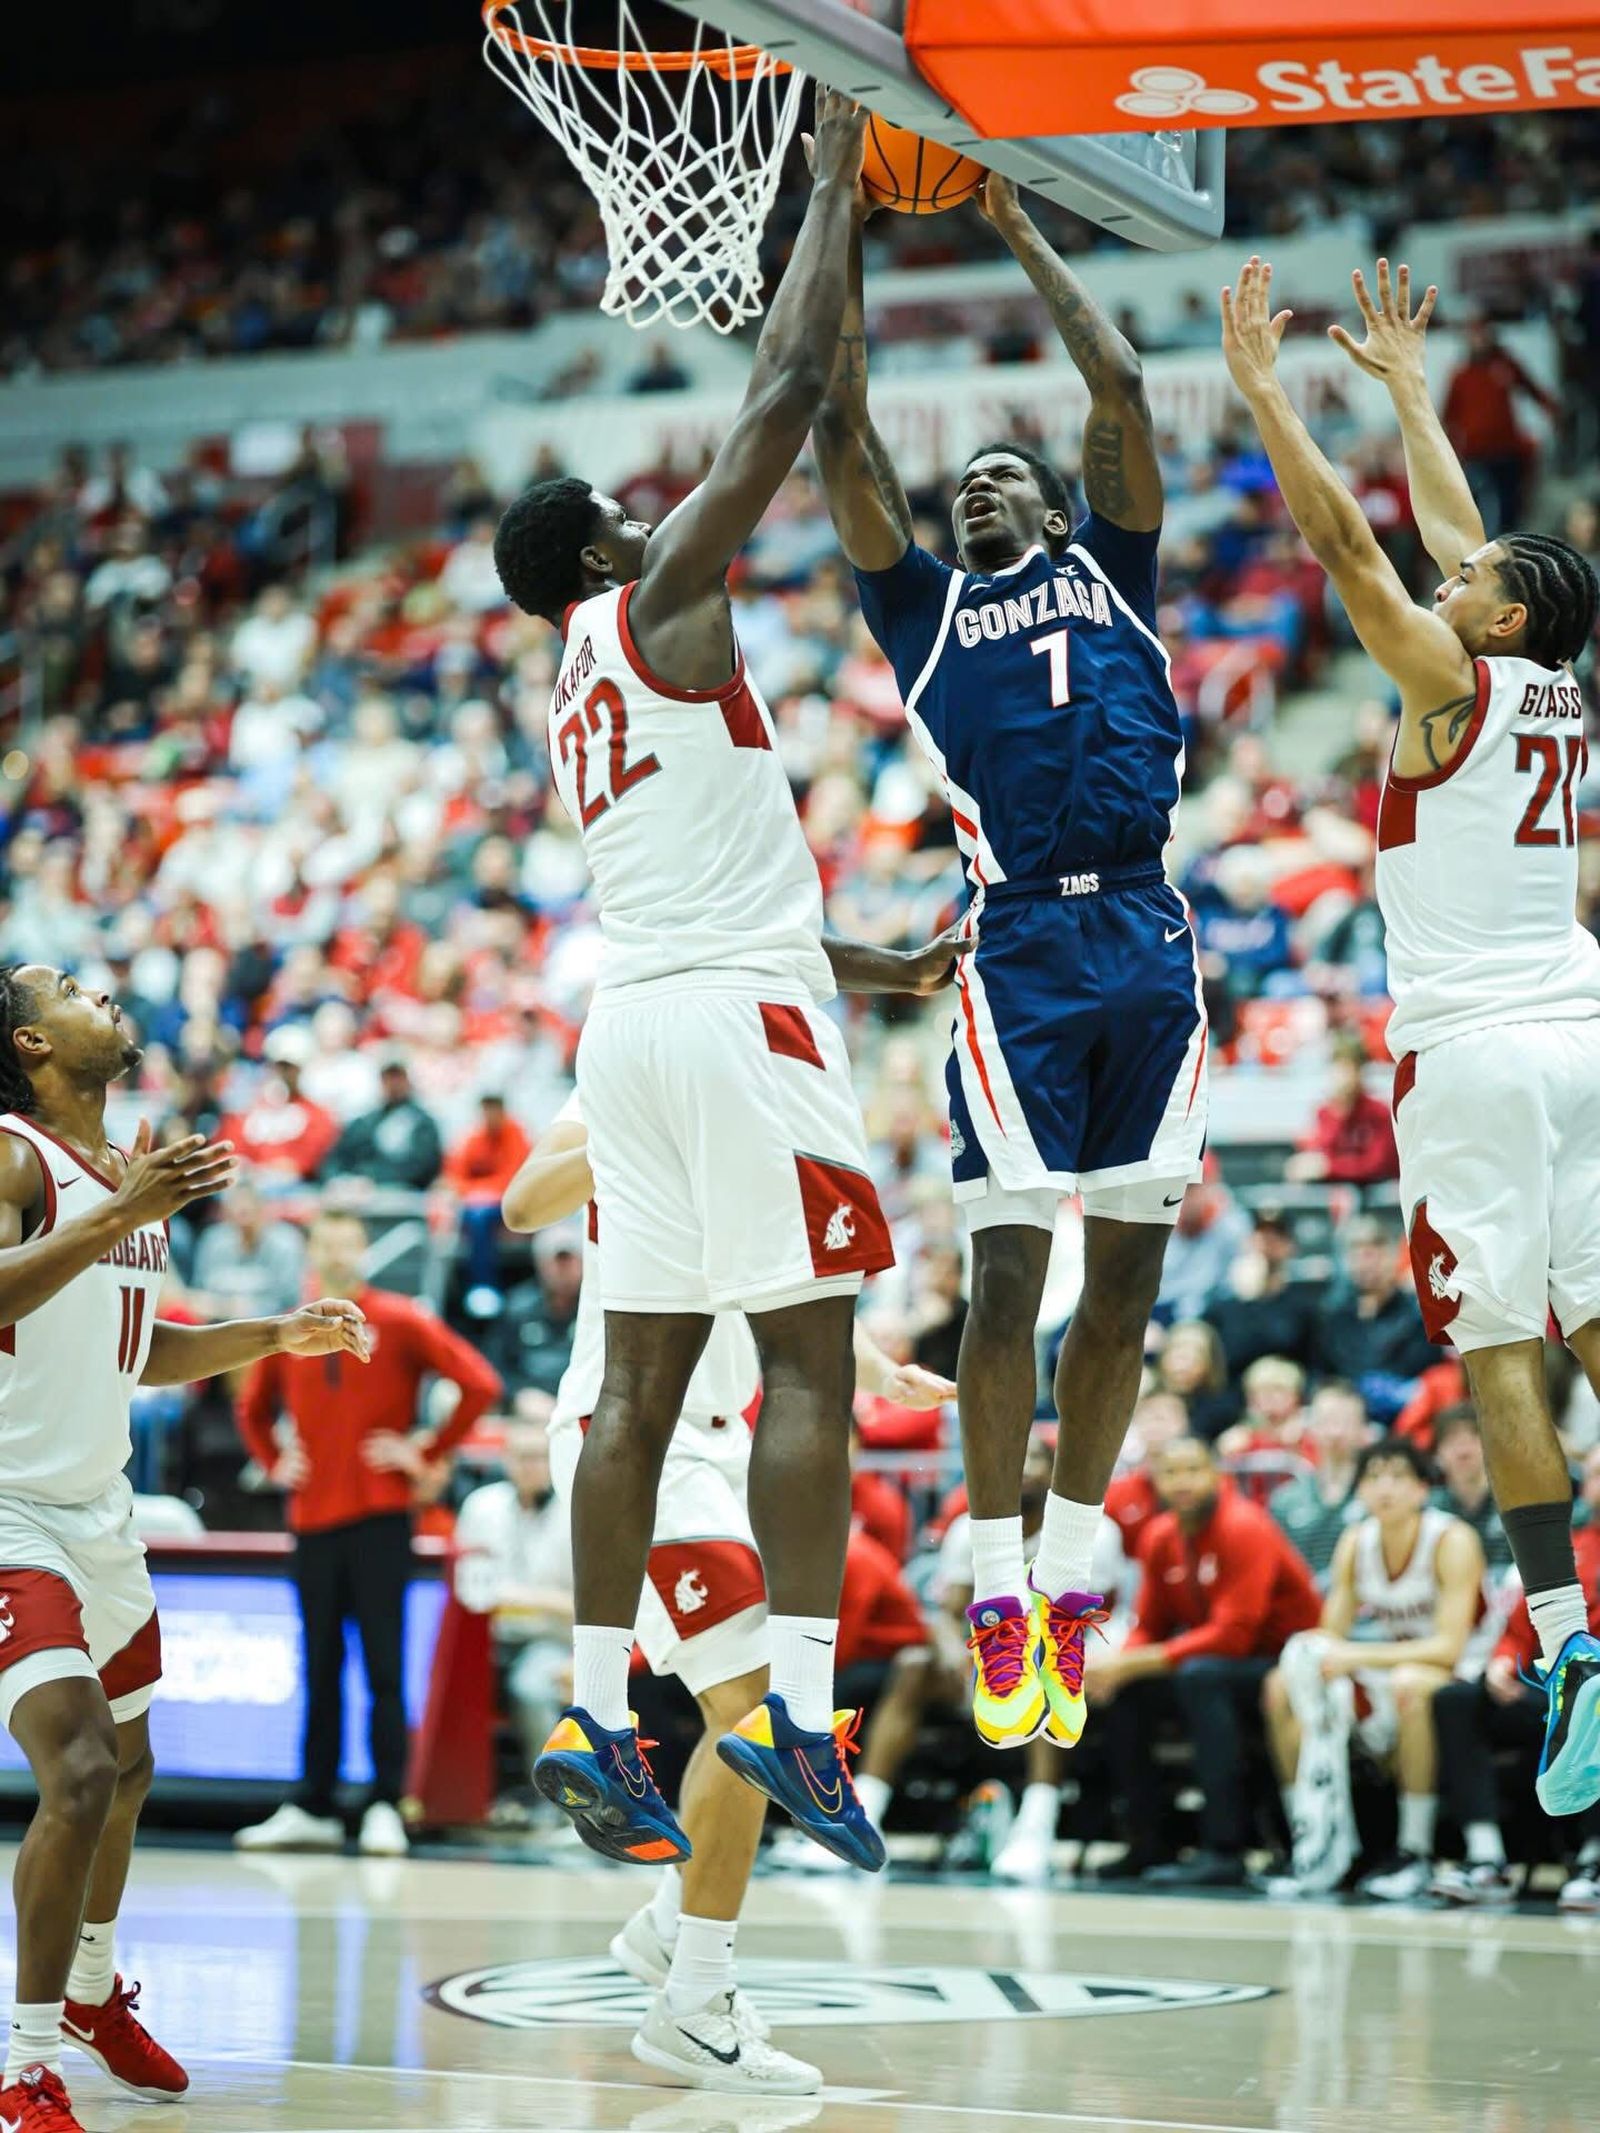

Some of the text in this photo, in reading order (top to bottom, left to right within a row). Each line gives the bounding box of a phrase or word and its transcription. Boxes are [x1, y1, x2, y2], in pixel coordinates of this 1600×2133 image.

[1256, 56, 1519, 112] State
[955, 577, 1113, 648] GONZAGA
[555, 635, 597, 715] OKAFOR
[1030, 628, 1071, 708] 1
[1519, 683, 1582, 719] GLASS
[558, 677, 663, 834] 22
[1059, 872, 1100, 897] ZAGS
[96, 1230, 168, 1273] UGARS
[118, 1281, 146, 1374] 11
